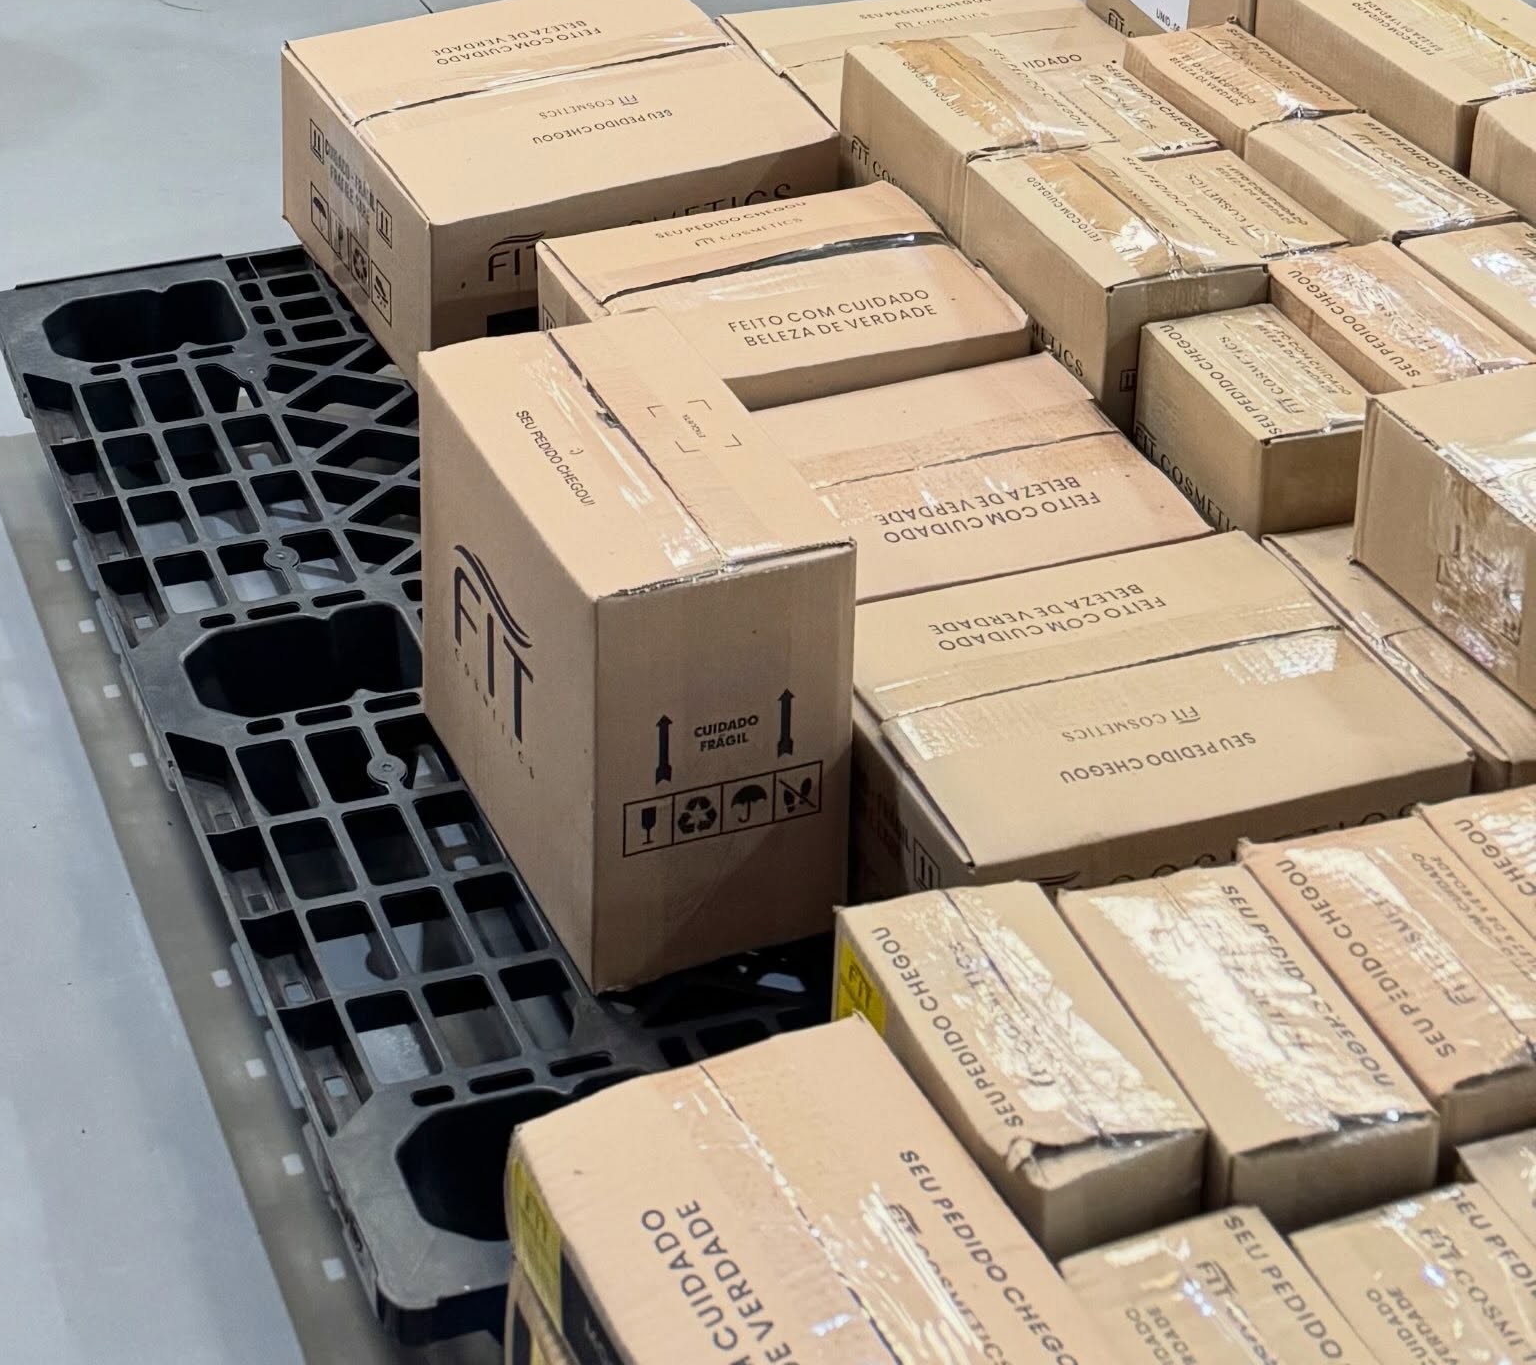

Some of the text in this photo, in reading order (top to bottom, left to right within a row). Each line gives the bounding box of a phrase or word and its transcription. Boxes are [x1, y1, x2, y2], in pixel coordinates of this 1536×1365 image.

[432, 37, 507, 56] VERDADE
[437, 27, 602, 65] FEITO COM CUIDADO
[530, 20, 587, 35] BELEZA
[532, 109, 673, 144] SEU PEDIDO CHEGOU
[539, 99, 614, 119] COSMETICS
[1158, 104, 1209, 140] CHEGOU
[851, 136, 870, 166] FIT
[1026, 176, 1065, 210] CUIDADO
[1438, 168, 1500, 206] CHEGOU
[655, 201, 807, 239] SEU PEDIDO CHEGOU
[1185, 207, 1239, 247] CHEGOU
[728, 289, 930, 333] FEITO COM CUIDADO
[1288, 269, 1345, 317] CHEGOU
[744, 304, 938, 347] BELEZA DE VERDADE
[1342, 314, 1392, 357] PEDIDO
[1160, 323, 1283, 437] SEU PEDIDO CHEGOU
[1218, 335, 1304, 414] FIT COSMETICS
[1388, 356, 1421, 378] SEU
[516, 410, 596, 507] SEU PEDIDO CHEGOU!
[878, 476, 1082, 526] BELEZA DE VERDADE
[884, 491, 1102, 544] FEITO COM CUIDADO
[929, 584, 1144, 636] BELEZA DE VERDADE
[938, 596, 1167, 651] FEITO COM CUIDADO
[454, 553, 534, 743] FIT
[694, 715, 759, 738] CUIDADO
[700, 732, 749, 752] FRÁGIL
[1062, 705, 1201, 743] FIT COSMETICS
[1060, 732, 1257, 785] SEU PEDIDO CHEGOU
[1275, 859, 1353, 939] CHEGOU
[872, 926, 939, 1013] CHEGOU
[1220, 884, 1396, 1087] SEU CHEGOU
[1349, 942, 1421, 1017] PEDIDO
[932, 1016, 995, 1090] PEDIDO
[1413, 1016, 1457, 1059] SEU
[985, 1081, 1024, 1128] SEU
[899, 1149, 943, 1193] SEU
[934, 1198, 1008, 1284] PEDIDO
[1419, 1227, 1462, 1266] FIT
[640, 1207, 739, 1351] CUIDADO
[676, 1199, 775, 1343] VERDADE
[1196, 1260, 1238, 1298] FIT
[1224, 1215, 1269, 1263] SEU
[1260, 1264, 1344, 1361] PEDIDO
